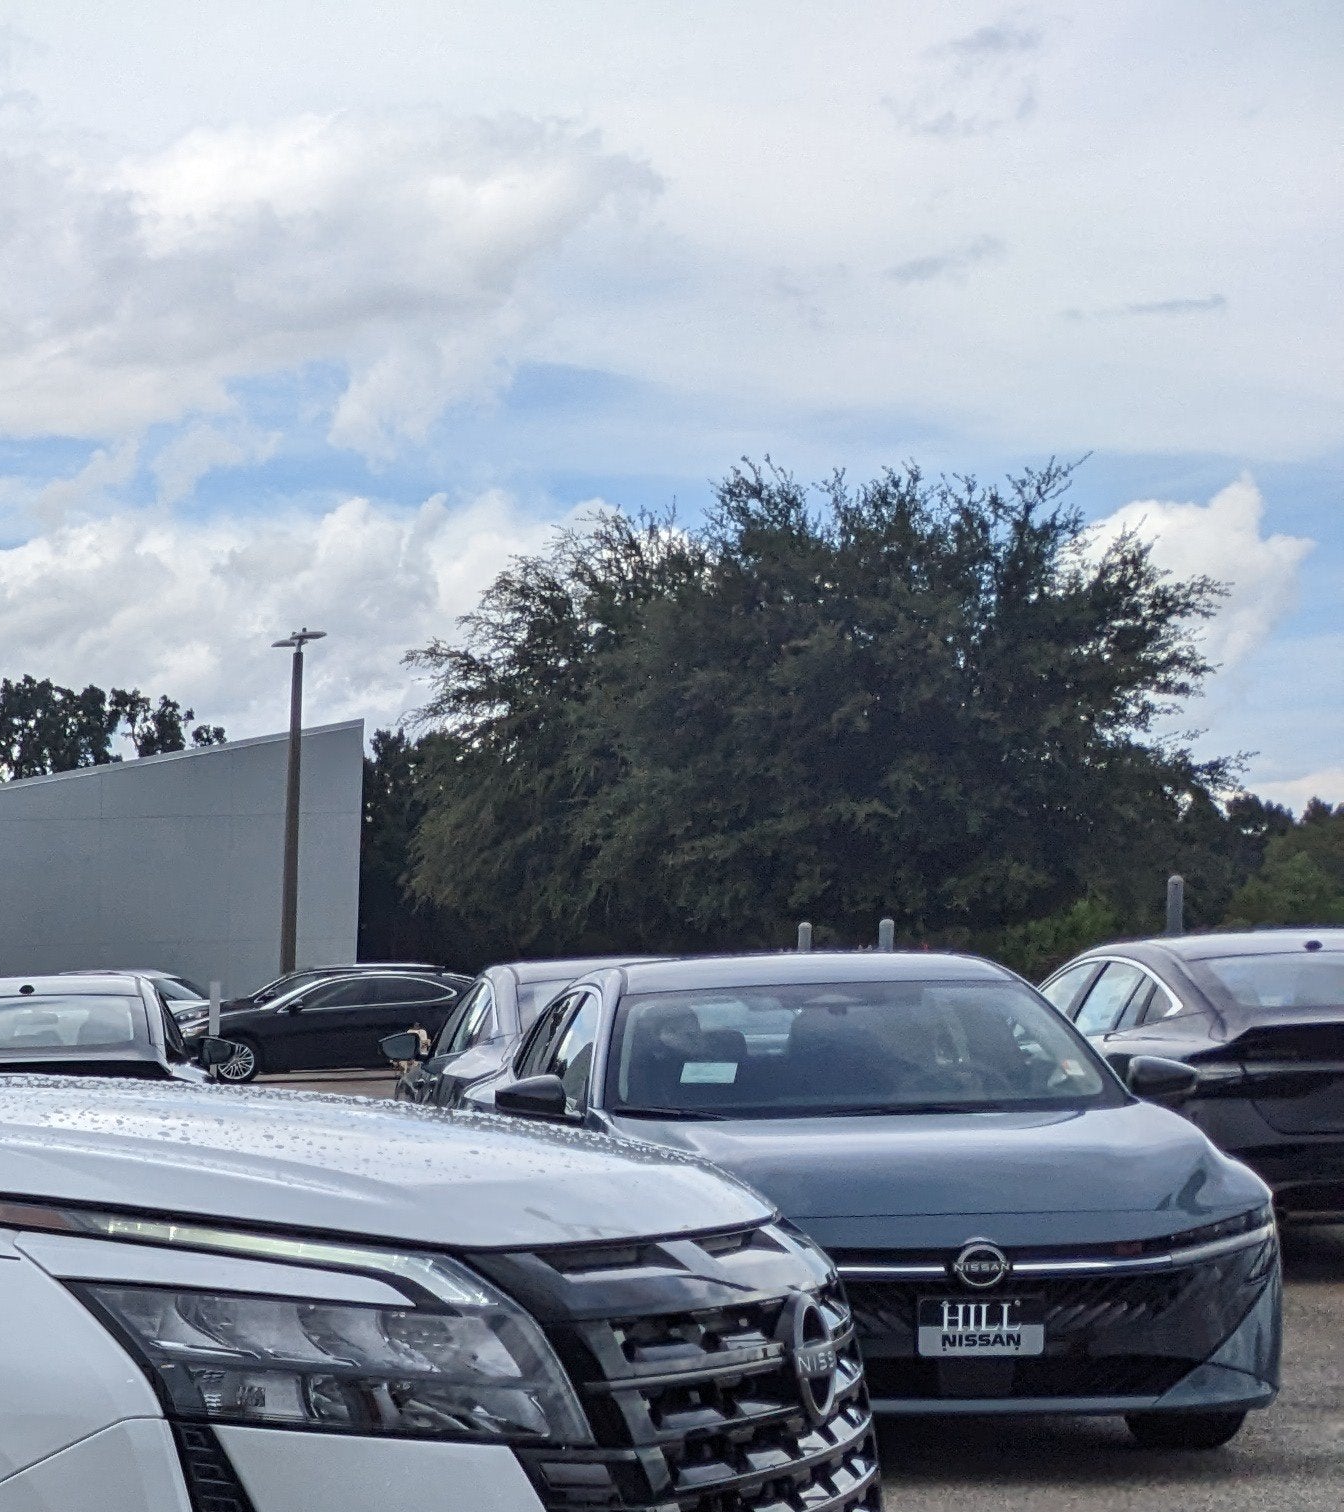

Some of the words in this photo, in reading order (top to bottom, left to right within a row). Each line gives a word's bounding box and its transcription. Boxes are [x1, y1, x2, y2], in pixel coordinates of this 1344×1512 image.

[953, 1261, 1010, 1272] NISSAN
[941, 1303, 1021, 1332] HILL
[941, 1333, 1021, 1348] NISSAN
